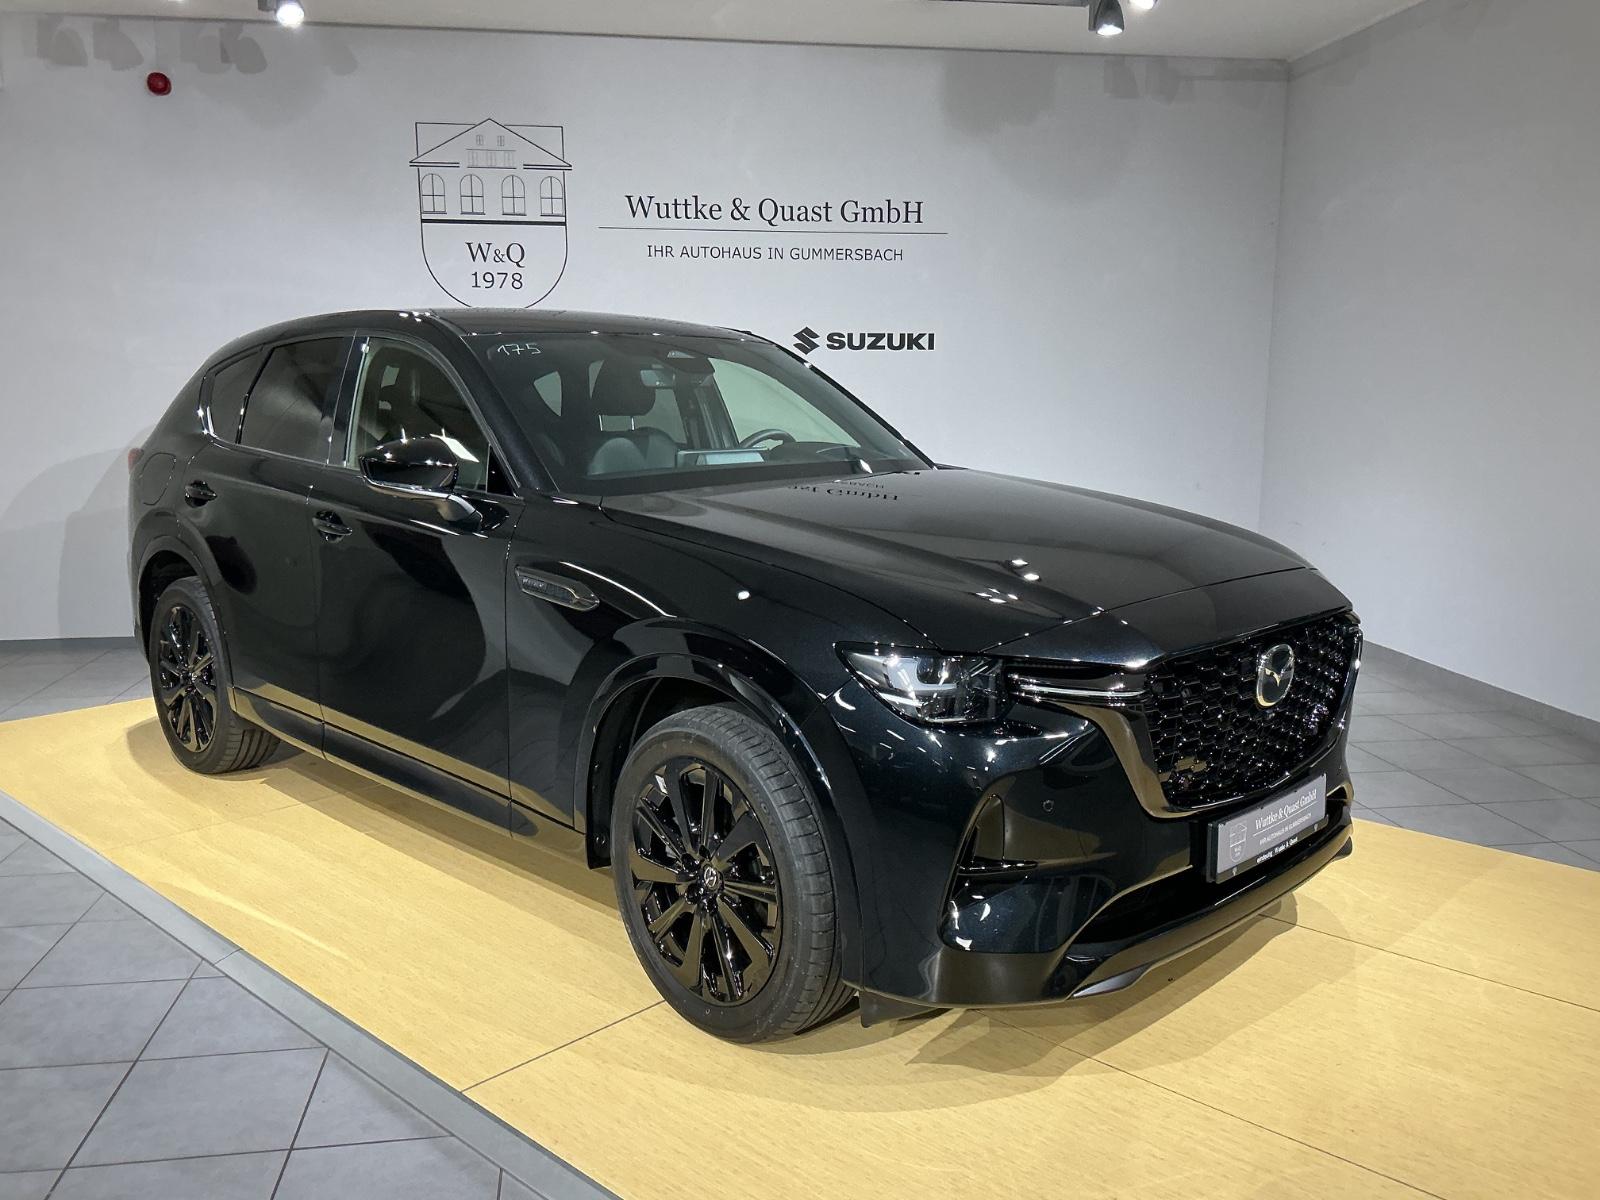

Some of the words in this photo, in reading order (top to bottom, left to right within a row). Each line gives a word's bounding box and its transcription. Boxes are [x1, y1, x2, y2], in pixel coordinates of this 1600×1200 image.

[624, 194, 722, 221] Wuttke
[730, 197, 751, 221] &
[758, 198, 833, 226] Quast
[840, 199, 924, 224] GmbH
[465, 242, 525, 267] W&Q
[647, 244, 675, 258] IHR
[679, 245, 762, 260] AUTOHAUS
[767, 247, 784, 260] IN
[789, 247, 903, 262] GUMMERSBACH
[471, 271, 523, 290] 1978
[497, 342, 541, 356] 175
[826, 332, 935, 351] SUZUKI
